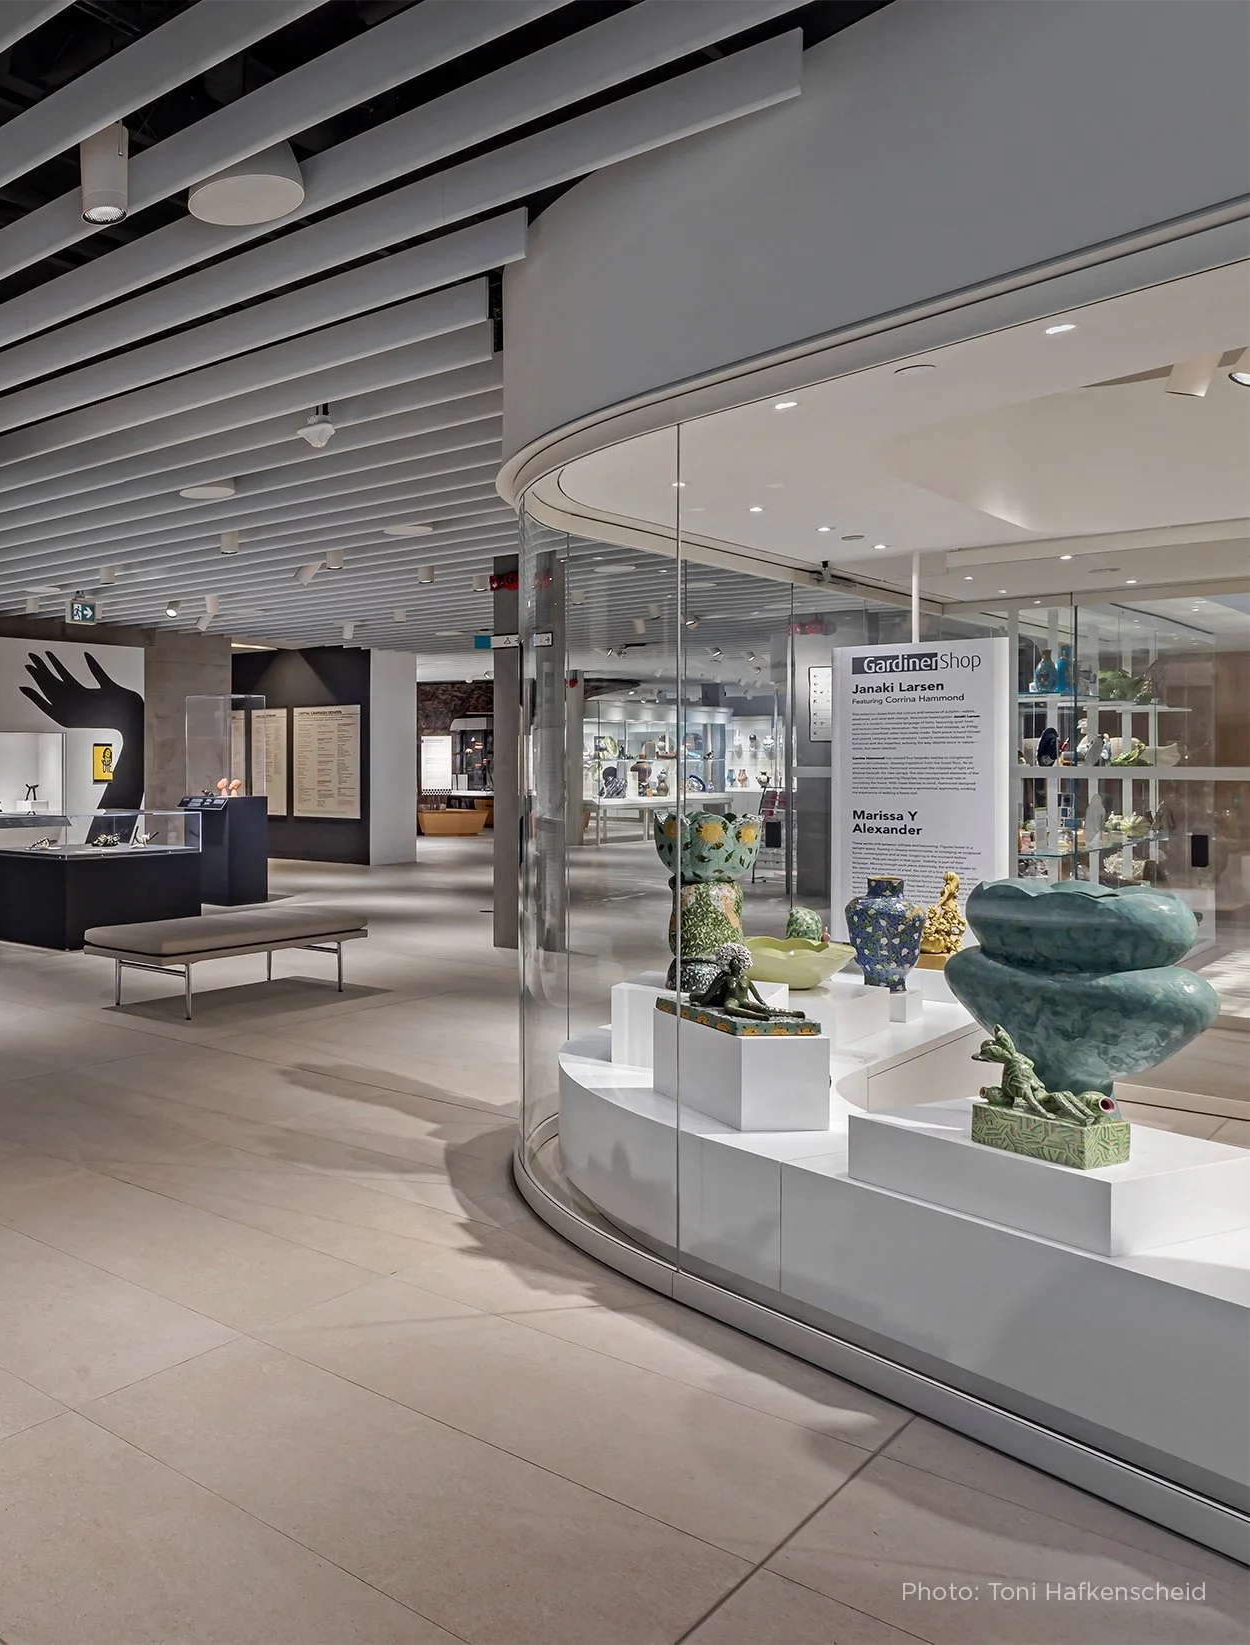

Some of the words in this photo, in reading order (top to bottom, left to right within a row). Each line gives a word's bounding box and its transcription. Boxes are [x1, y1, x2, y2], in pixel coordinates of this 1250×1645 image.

[852, 683, 894, 694] Janaki
[899, 682, 944, 692] Larsen
[852, 697, 882, 705] Featuring
[885, 695, 916, 703] Corrina
[918, 694, 964, 702] Hammond
[852, 810, 903, 821] Marissa
[906, 811, 918, 821] Y
[853, 823, 922, 835] Alexander
